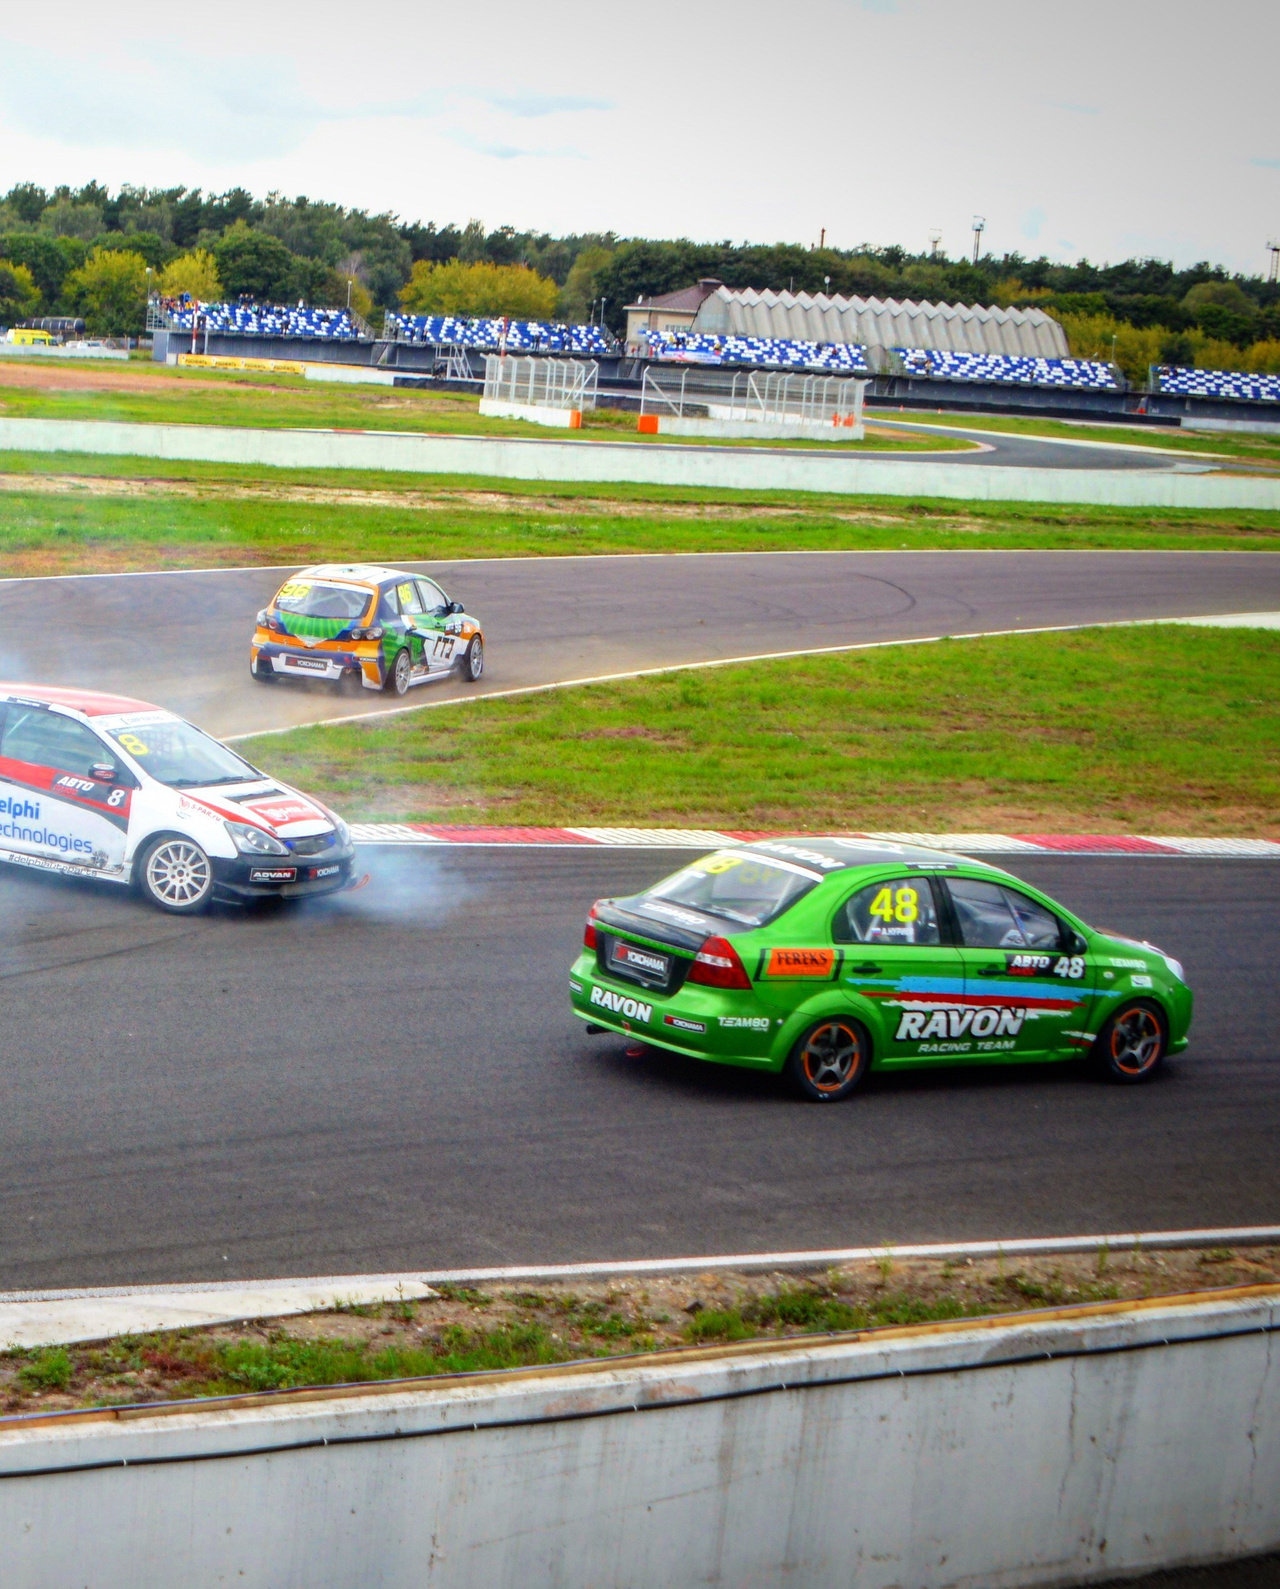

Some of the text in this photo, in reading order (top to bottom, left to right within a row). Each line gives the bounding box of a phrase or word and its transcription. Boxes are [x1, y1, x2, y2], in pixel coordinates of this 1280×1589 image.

[281, 584, 313, 598] 96
[398, 583, 412, 605] 96
[118, 734, 149, 755] 8
[57, 776, 95, 792] АВТО
[107, 789, 125, 807] 8
[191, 804, 222, 822] S-PAR.ru
[869, 887, 919, 923] 48
[626, 950, 665, 972] YOKOHAMA
[776, 951, 828, 966] FEREKS
[1011, 955, 1050, 967] АВТО
[1053, 956, 1085, 979] 48
[589, 985, 654, 1023] RAVON
[894, 1007, 1027, 1041] RAVON
[917, 1040, 1016, 1053] RACING TEAM
